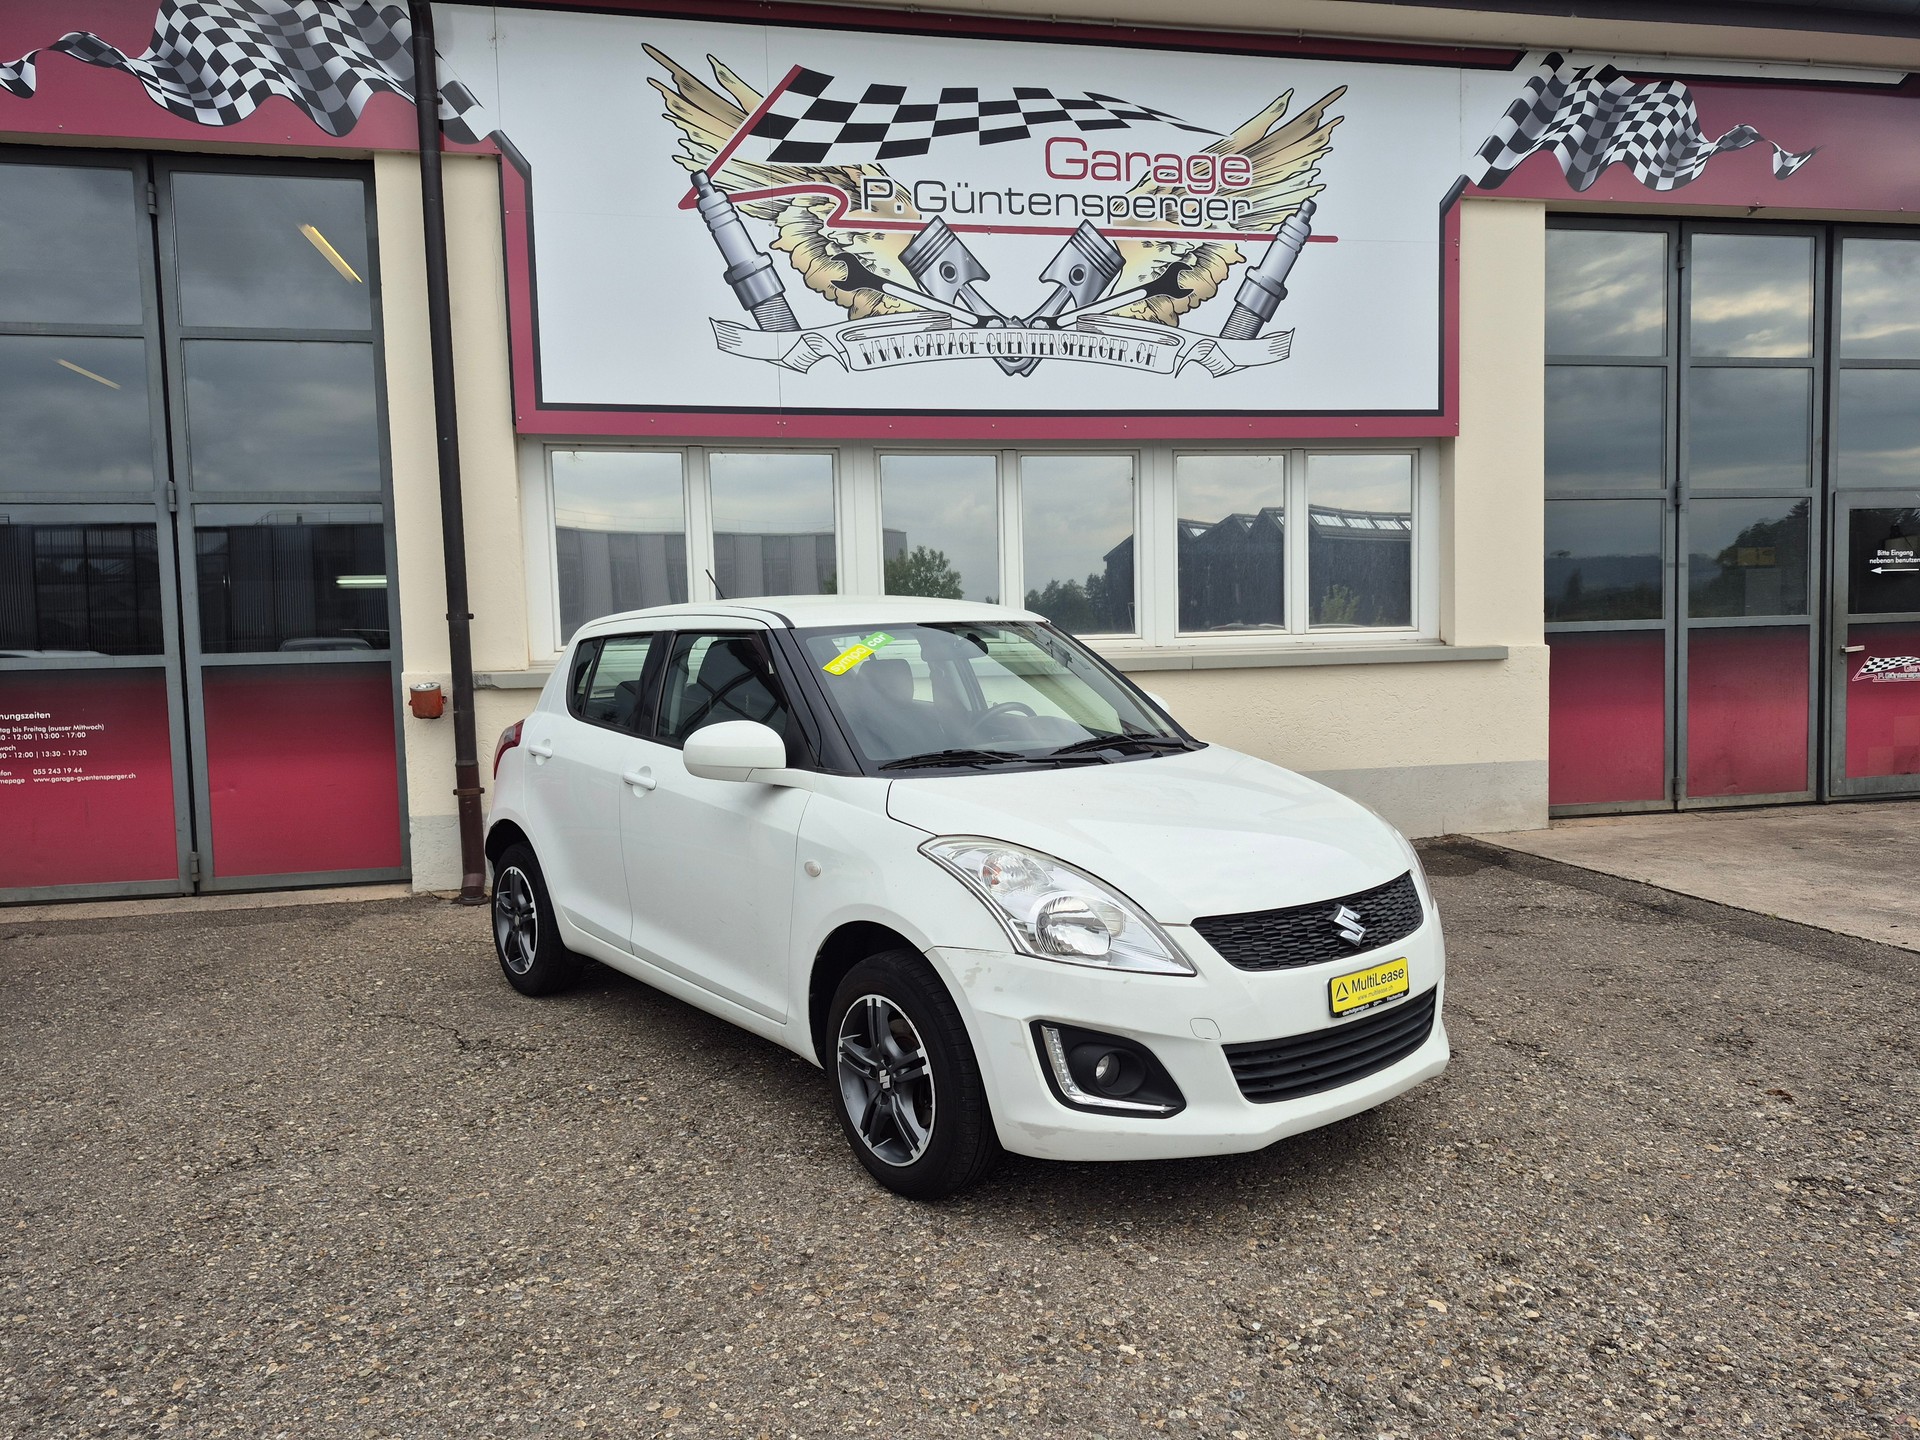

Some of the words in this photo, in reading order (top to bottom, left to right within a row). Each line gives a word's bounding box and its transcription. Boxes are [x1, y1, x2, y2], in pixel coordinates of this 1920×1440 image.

[1045, 137, 1251, 195] Garage
[914, 180, 1250, 226] Güntensperger
[859, 332, 1159, 367] WWW.GARAGE-GUENTENSPERGER.CH
[1891, 549, 1914, 558] Eingang
[23, 725, 47, 733] Freitag
[13, 733, 33, 741] 12:00
[40, 732, 60, 740] 13:00
[14, 751, 34, 759] 12:00
[41, 750, 61, 758] 13:30
[68, 749, 88, 757] 17:30
[48, 767, 61, 775] 243
[33, 773, 136, 783] www.garage-guentensperger.ch
[1352, 968, 1404, 993] MultiLease
